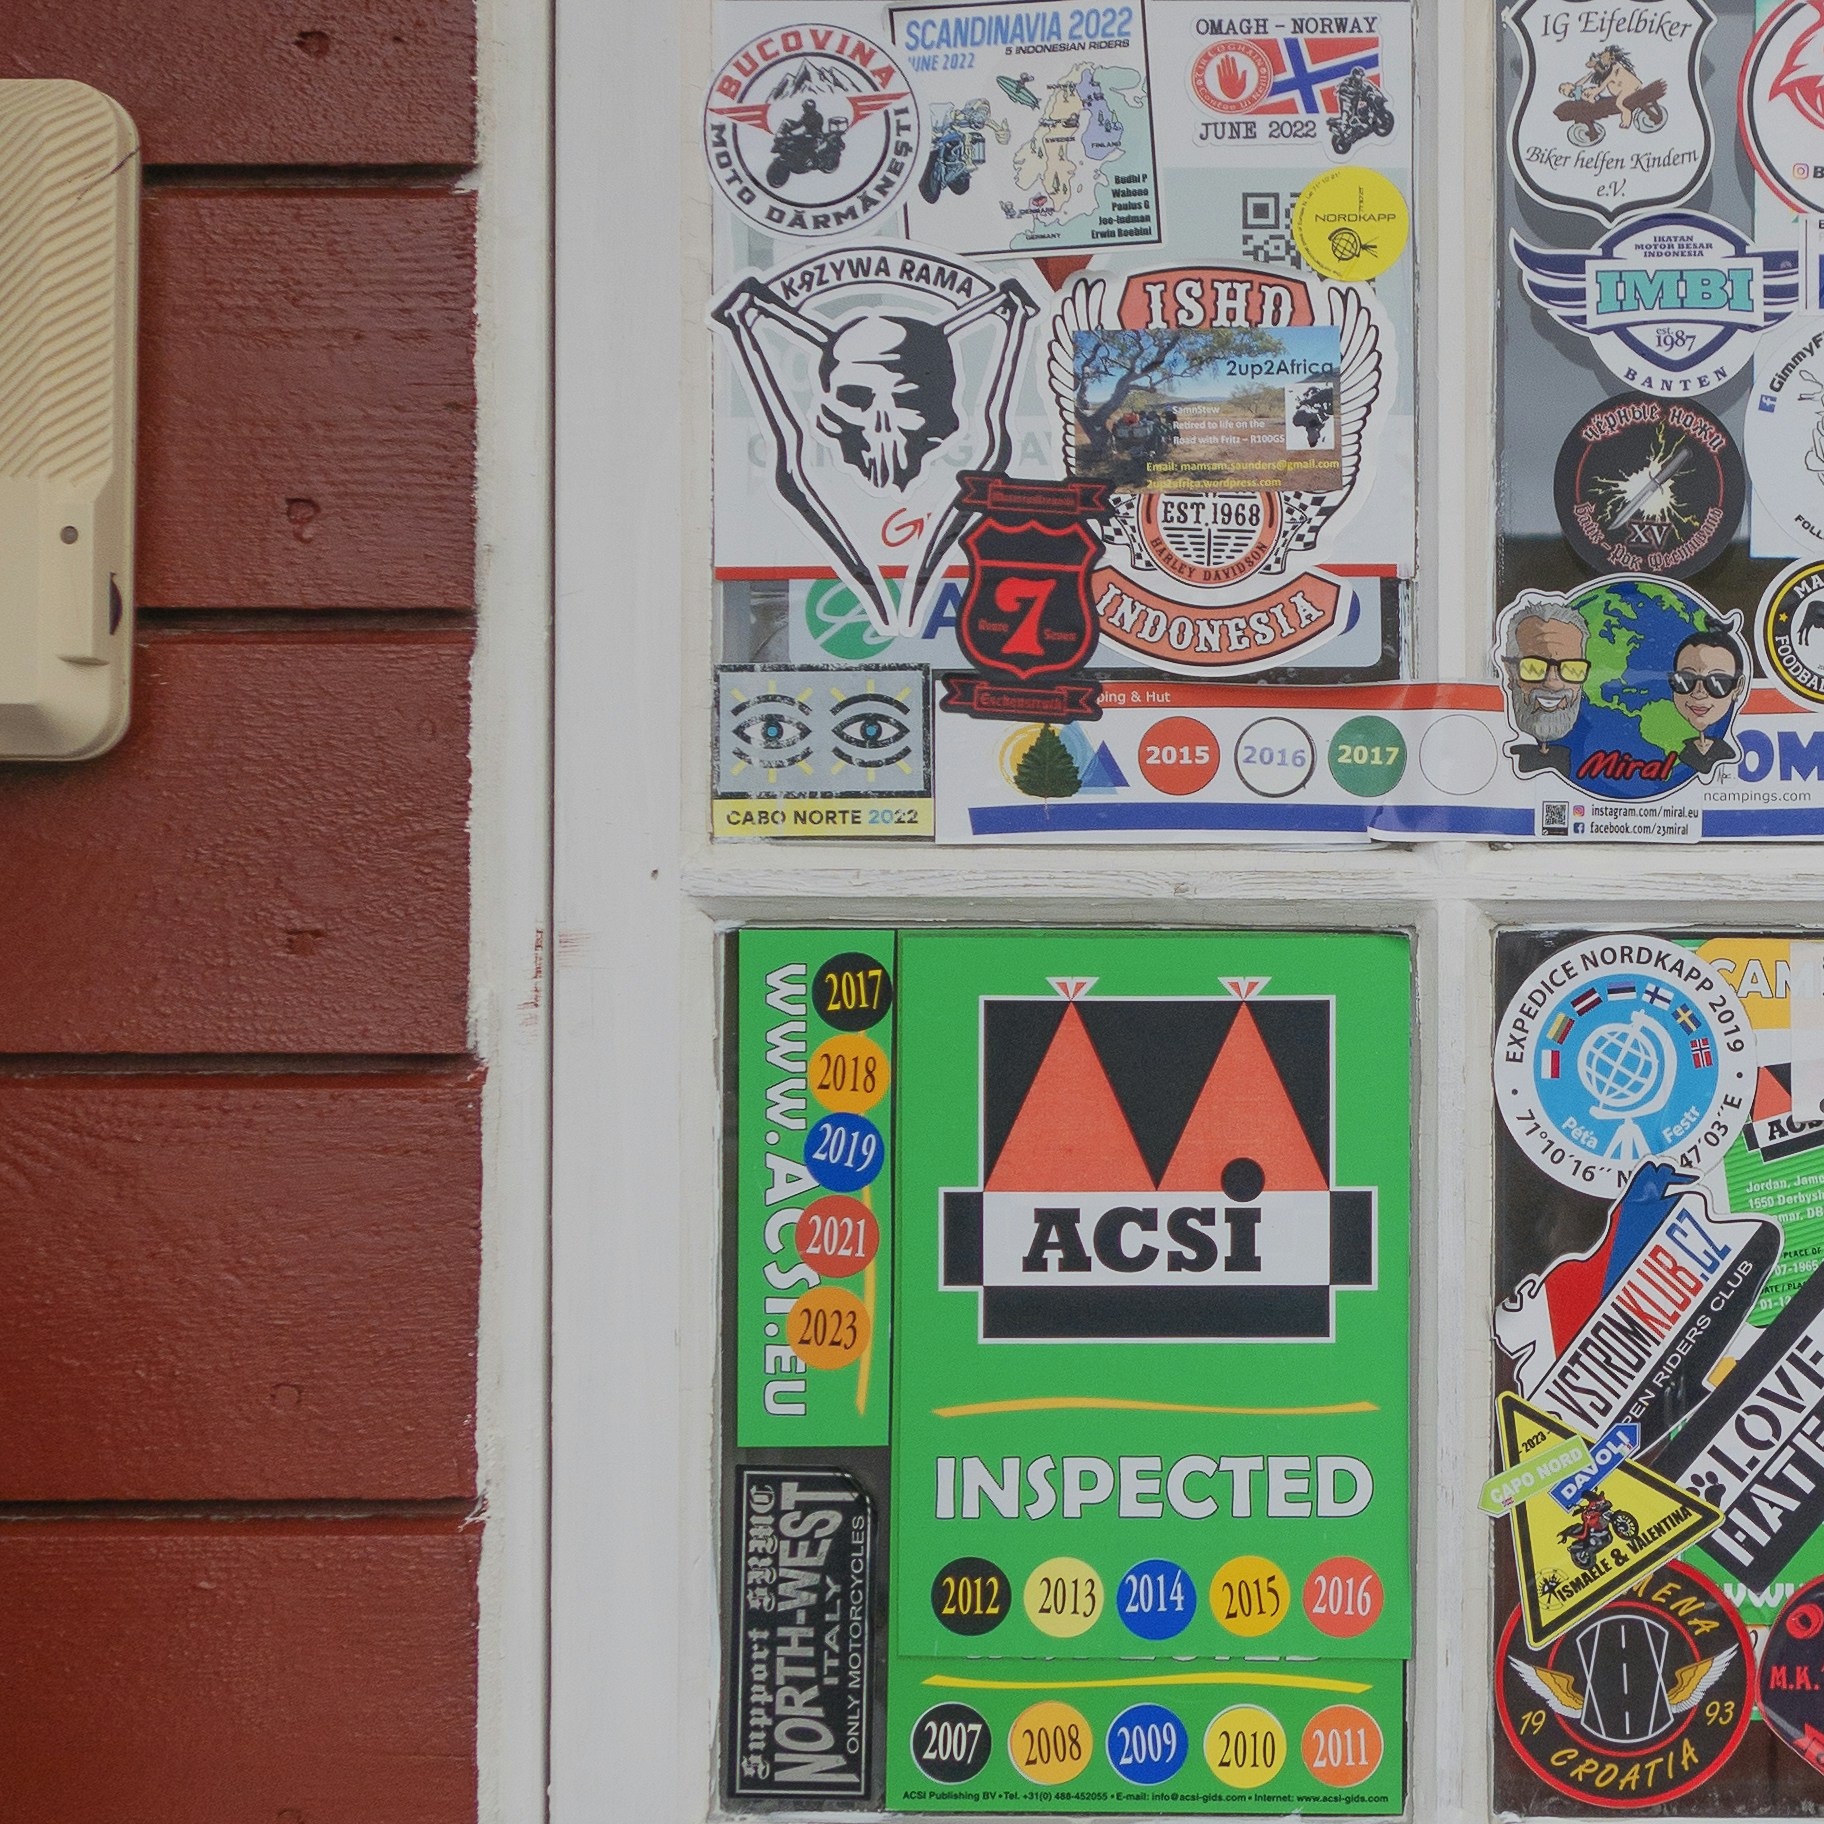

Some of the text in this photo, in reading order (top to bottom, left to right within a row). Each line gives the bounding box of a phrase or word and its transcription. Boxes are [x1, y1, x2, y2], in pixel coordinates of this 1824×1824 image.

[905, 6, 1134, 50] SCANDINAVIA 2022
[1196, 15, 1378, 35] OMAGH NORWAY
[1541, 8, 1692, 40] IG Eifelbiker
[716, 28, 894, 99] BUCOVINA
[1198, 121, 1317, 141] JUNE 2022
[1526, 146, 1698, 170] Biker helfen Kindern
[1595, 180, 1626, 197] e.V.
[1314, 213, 1396, 221] NORDKAPP
[1147, 282, 1295, 326] ISHD
[1596, 269, 1754, 311] IMBI
[1623, 366, 1729, 392] BANTEN
[1146, 459, 1339, 472] Email: mamsam.saunders@gmail.com
[1101, 584, 1324, 652] INDONESIA
[1145, 746, 1210, 764] 2015
[1242, 747, 1306, 767] 2016
[1336, 746, 1398, 763] 2017
[1578, 750, 1677, 782] Miral
[727, 810, 919, 825] CABO NORTE 2022
[1591, 805, 1699, 818] instagram.com/miral.eu
[1589, 822, 1689, 836] facebook.com/23miral
[825, 968, 883, 1011] 2017
[817, 1053, 877, 1093] 2018
[812, 1125, 877, 1173] 2019
[806, 1217, 866, 1258] 2021
[798, 1306, 858, 1349] 2023
[935, 1454, 1374, 1520] INSPECTED
[942, 1571, 1372, 1619] 2012 2013 2014 2015 2016
[923, 1721, 1368, 1769] 2007 2008 2009 2010 2011
[1549, 1743, 1699, 1791] CROATIA
